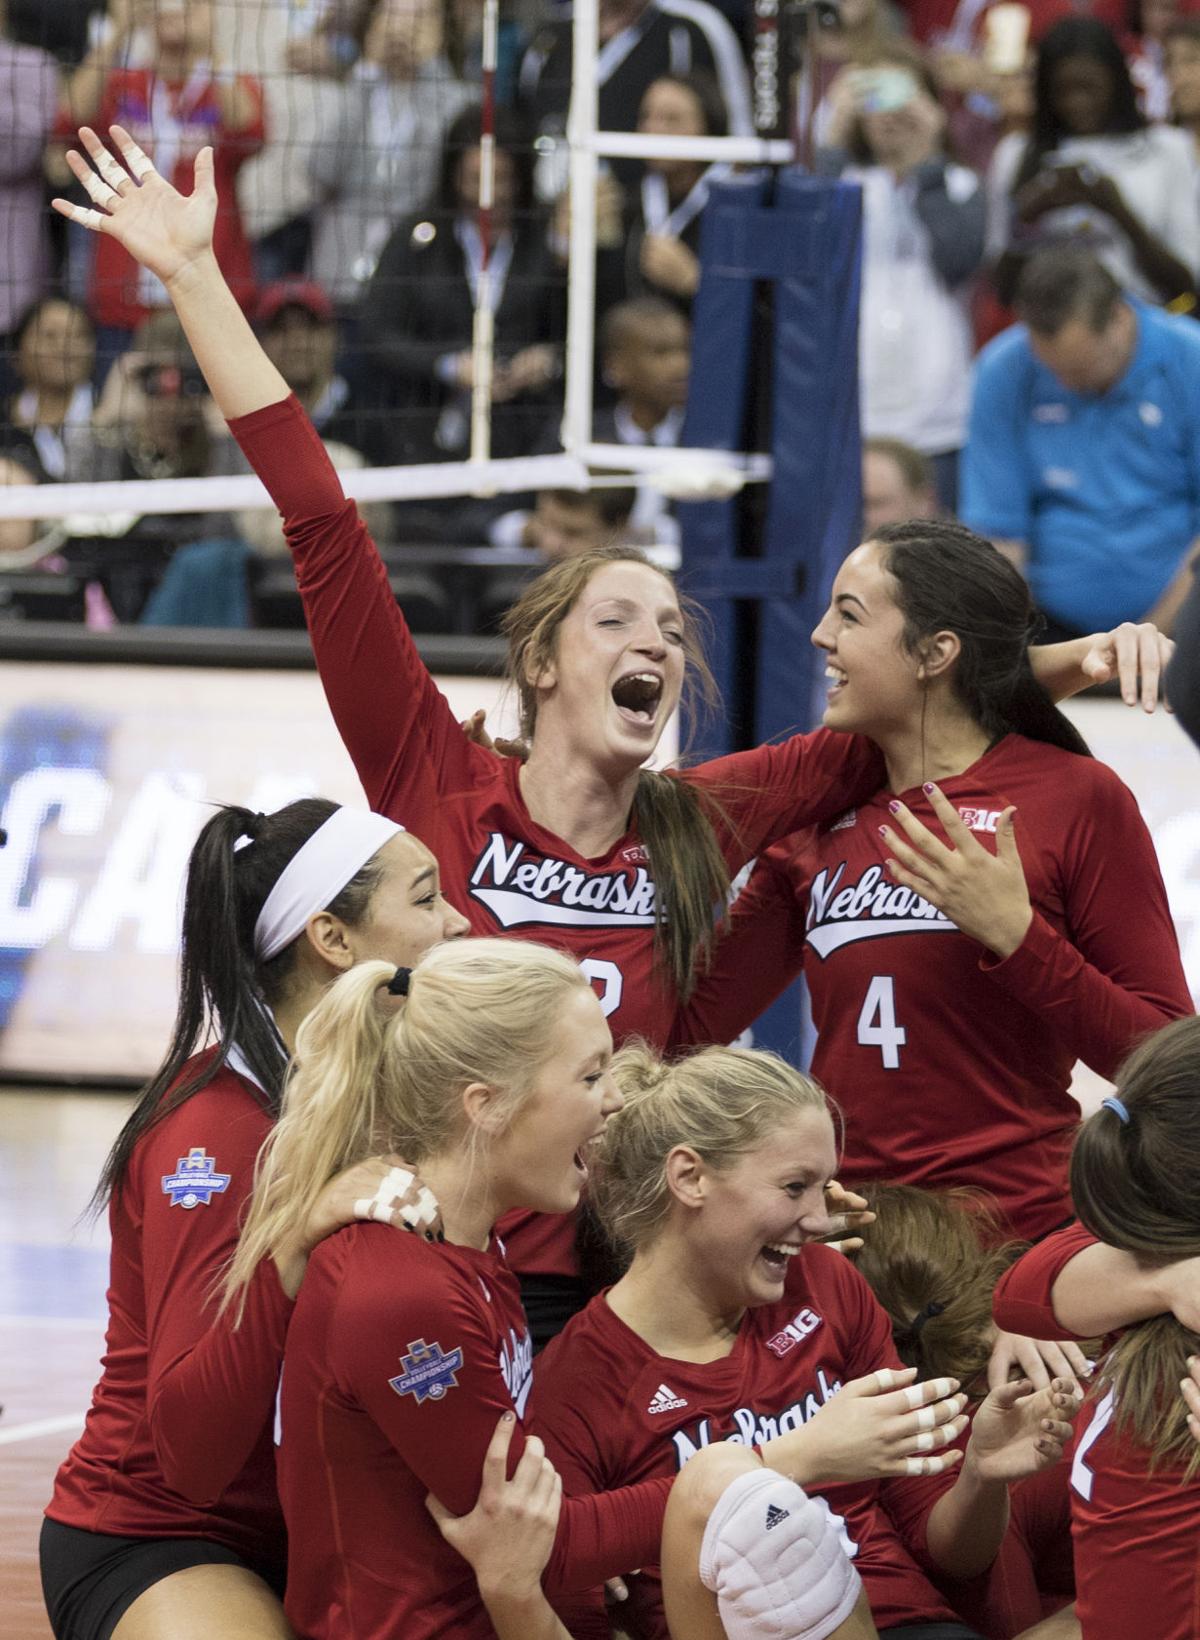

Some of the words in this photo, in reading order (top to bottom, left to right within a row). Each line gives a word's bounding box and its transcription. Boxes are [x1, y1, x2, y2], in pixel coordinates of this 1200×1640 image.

[470, 832, 668, 915] Nebrask
[805, 858, 949, 932] Nebras
[857, 975, 906, 1069] 4
[166, 1178, 225, 1190] CHAMPIONSHIP
[399, 1355, 458, 1389] CHAMPIONSHIP
[647, 1397, 689, 1415] adidas
[765, 1509, 791, 1531] adidas
